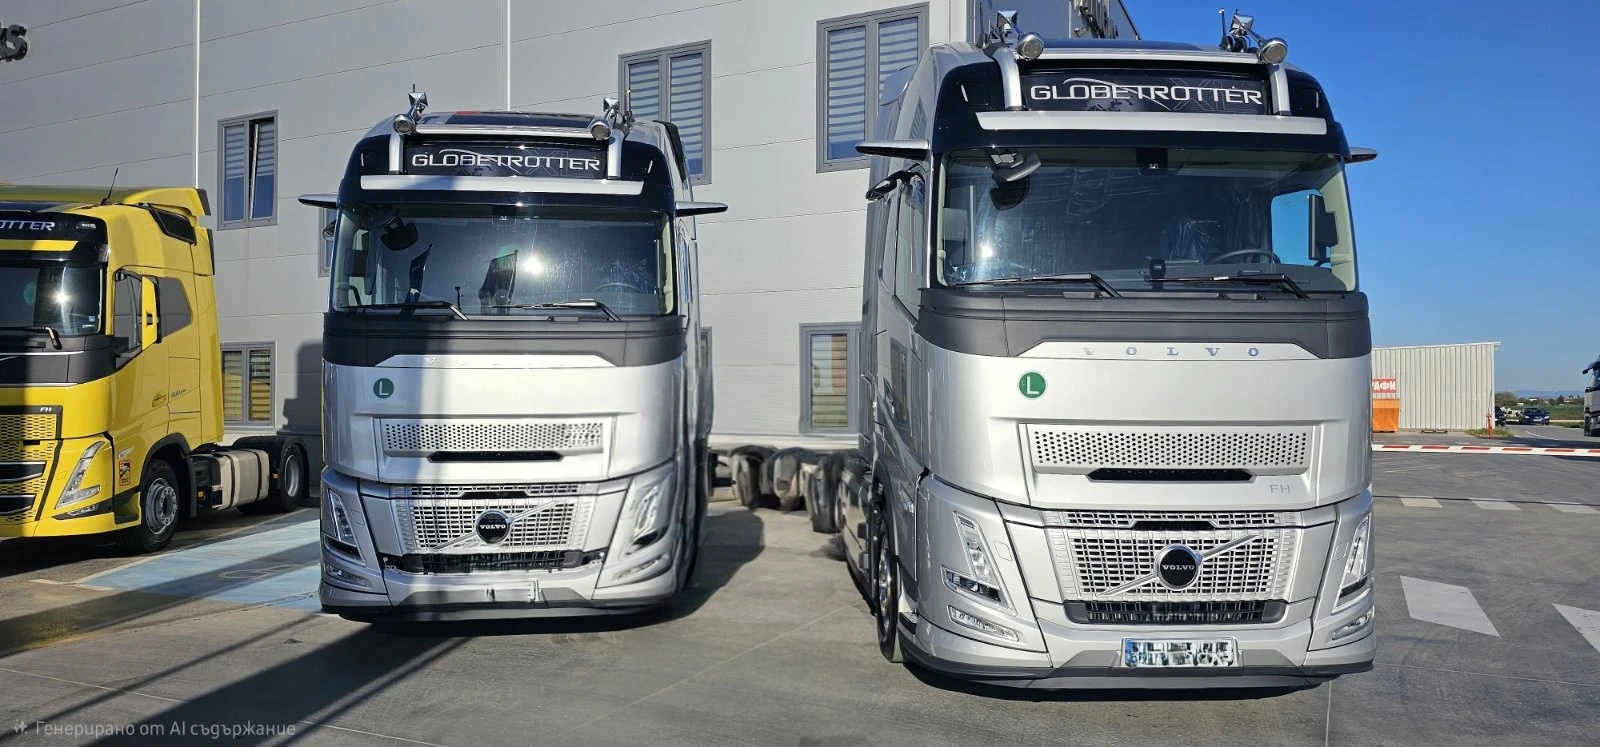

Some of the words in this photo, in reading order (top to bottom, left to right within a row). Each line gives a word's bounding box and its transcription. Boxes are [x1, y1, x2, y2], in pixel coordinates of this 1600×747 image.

[1030, 83, 1263, 105] GLOBETROTTER
[411, 152, 600, 171] GLOBETROTTER
[1082, 346, 1260, 357] VOLVO
[379, 380, 389, 396] L
[1027, 376, 1040, 395] L
[1270, 484, 1291, 495] FH
